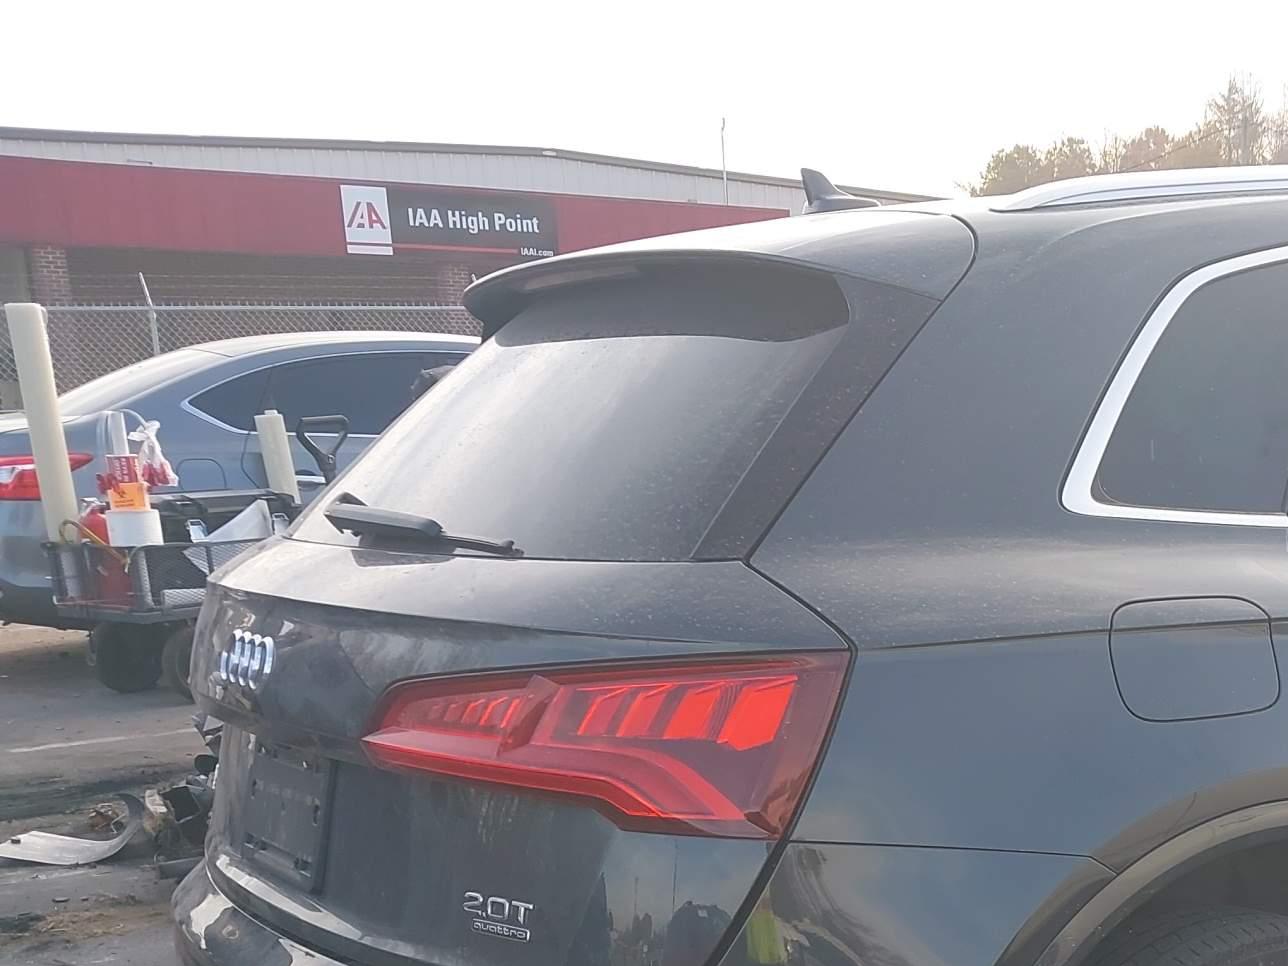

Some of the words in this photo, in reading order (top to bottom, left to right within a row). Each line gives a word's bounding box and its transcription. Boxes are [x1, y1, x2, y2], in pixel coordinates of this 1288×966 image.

[407, 207, 443, 228] IAA
[447, 210, 489, 234] High
[494, 213, 540, 233] Point
[463, 891, 534, 924] 2.0T
[473, 921, 526, 938] quattro
